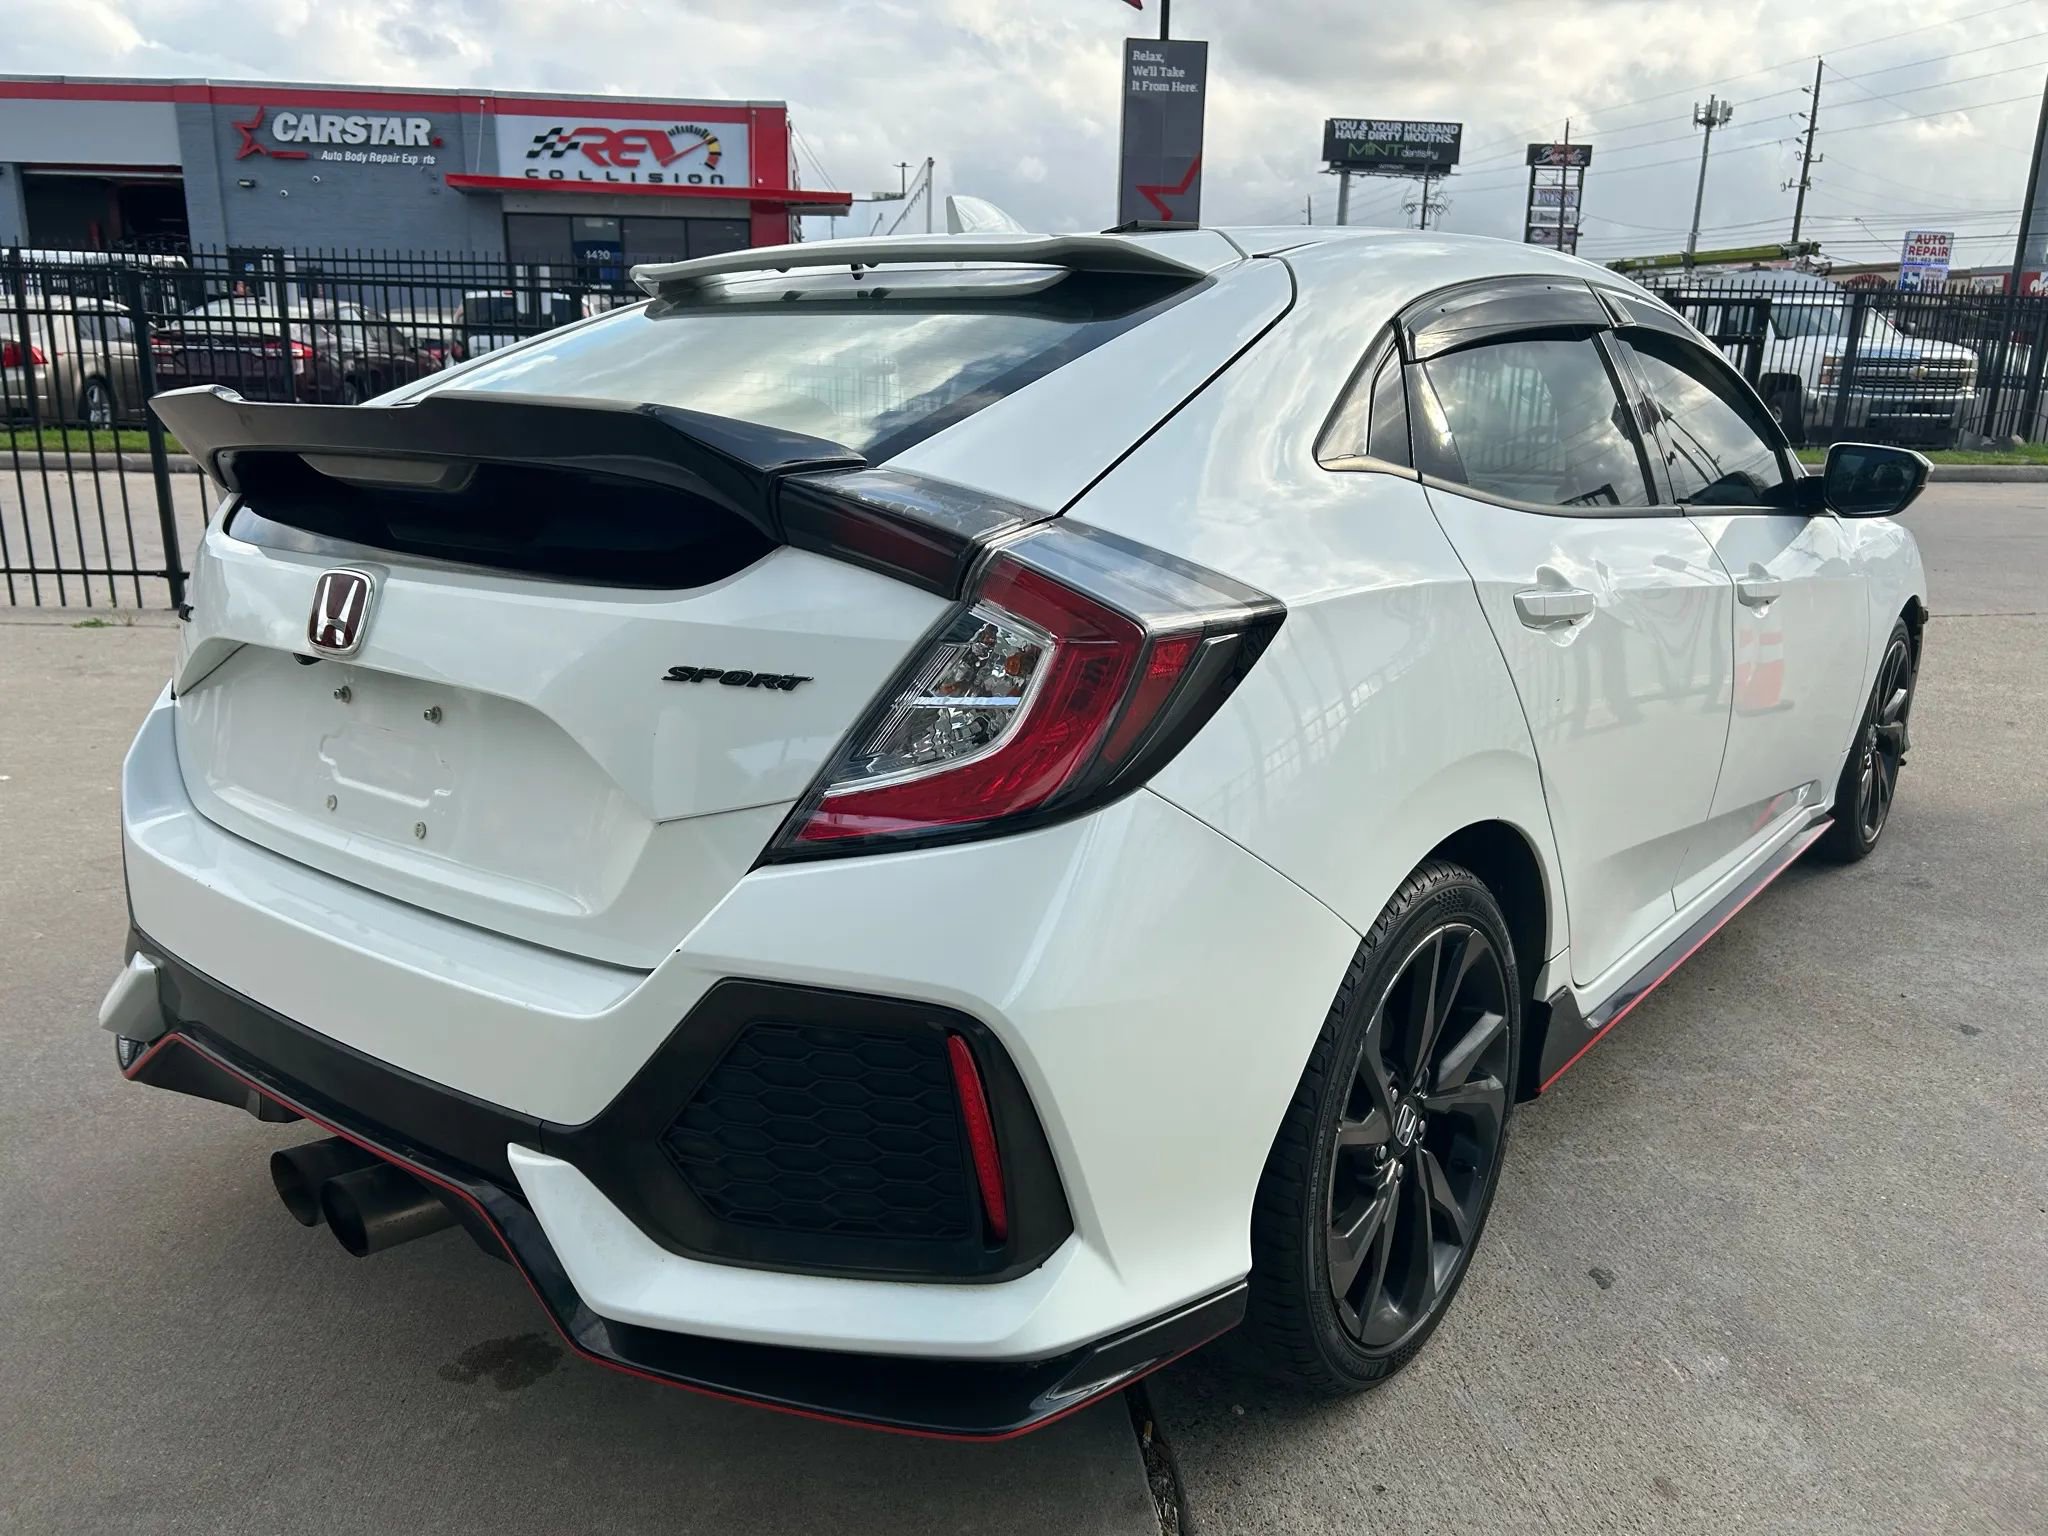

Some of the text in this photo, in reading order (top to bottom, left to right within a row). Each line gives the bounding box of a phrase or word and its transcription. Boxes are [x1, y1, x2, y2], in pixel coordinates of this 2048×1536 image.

[1132, 50, 1165, 63] Relax,
[1132, 65, 1185, 77] We'll Take
[1131, 80, 1140, 91] It
[1142, 80, 1170, 92] From
[271, 111, 432, 146] CARSTAR
[1333, 120, 1459, 135] YOU & YOUR HUSBAND
[1335, 130, 1367, 140] HAVE
[1368, 130, 1401, 141] DIRTY
[563, 127, 688, 168] REV
[1347, 142, 1404, 158] MINT
[321, 150, 342, 161] Auto
[344, 151, 368, 164] Body
[369, 152, 400, 165] Repair
[524, 168, 725, 185] COLLISION
[1915, 234, 1946, 245] AUTO
[1908, 245, 1949, 257] REPAIR
[661, 666, 815, 691] SPORT
